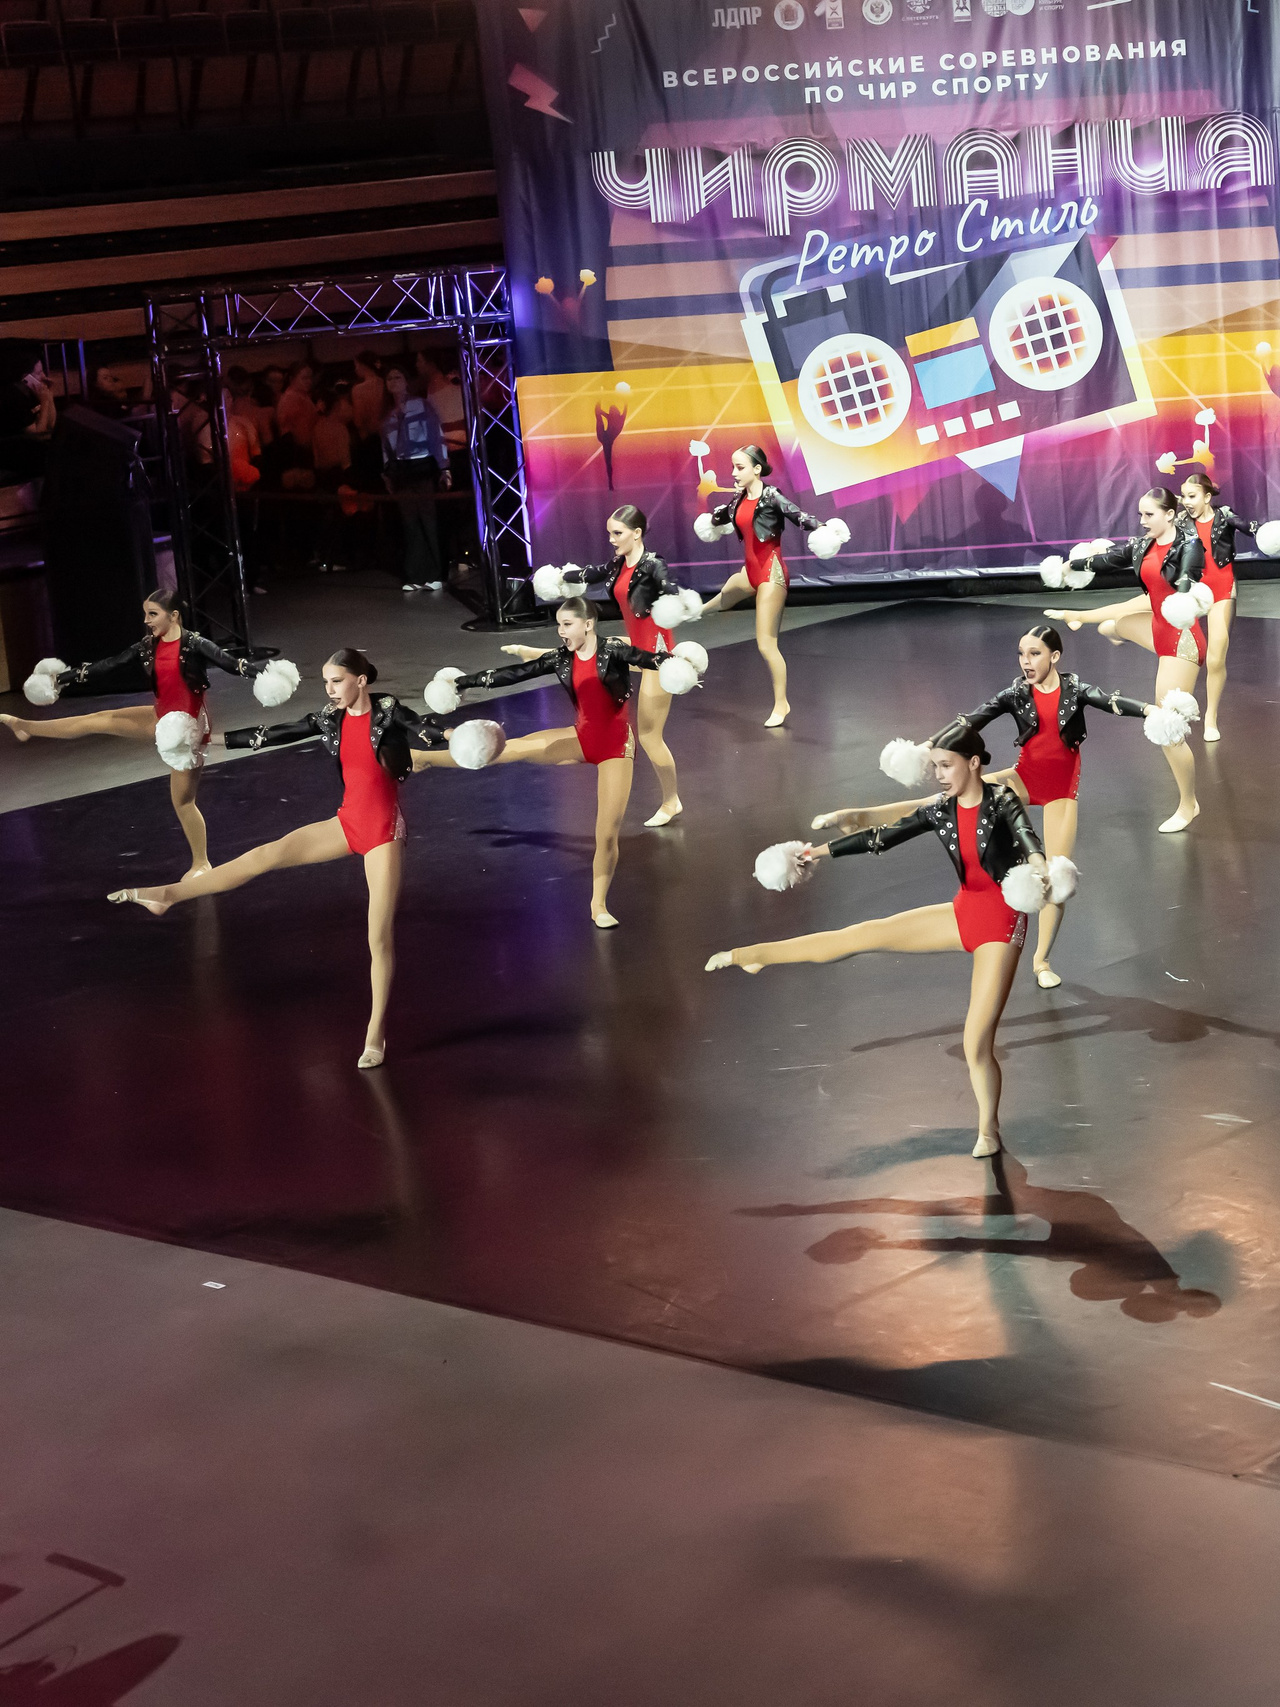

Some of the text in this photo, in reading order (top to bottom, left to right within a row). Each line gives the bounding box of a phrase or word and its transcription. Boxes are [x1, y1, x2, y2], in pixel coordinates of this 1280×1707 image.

[712, 7, 762, 29] ЛДПР
[662, 40, 1188, 88] ВСЕРОССИЙСКИЕ СОРЕВНОВАНИЯ
[803, 72, 1049, 104] ПО ЧИР СПОРТУ
[794, 198, 1100, 285] Ретро Стиль
